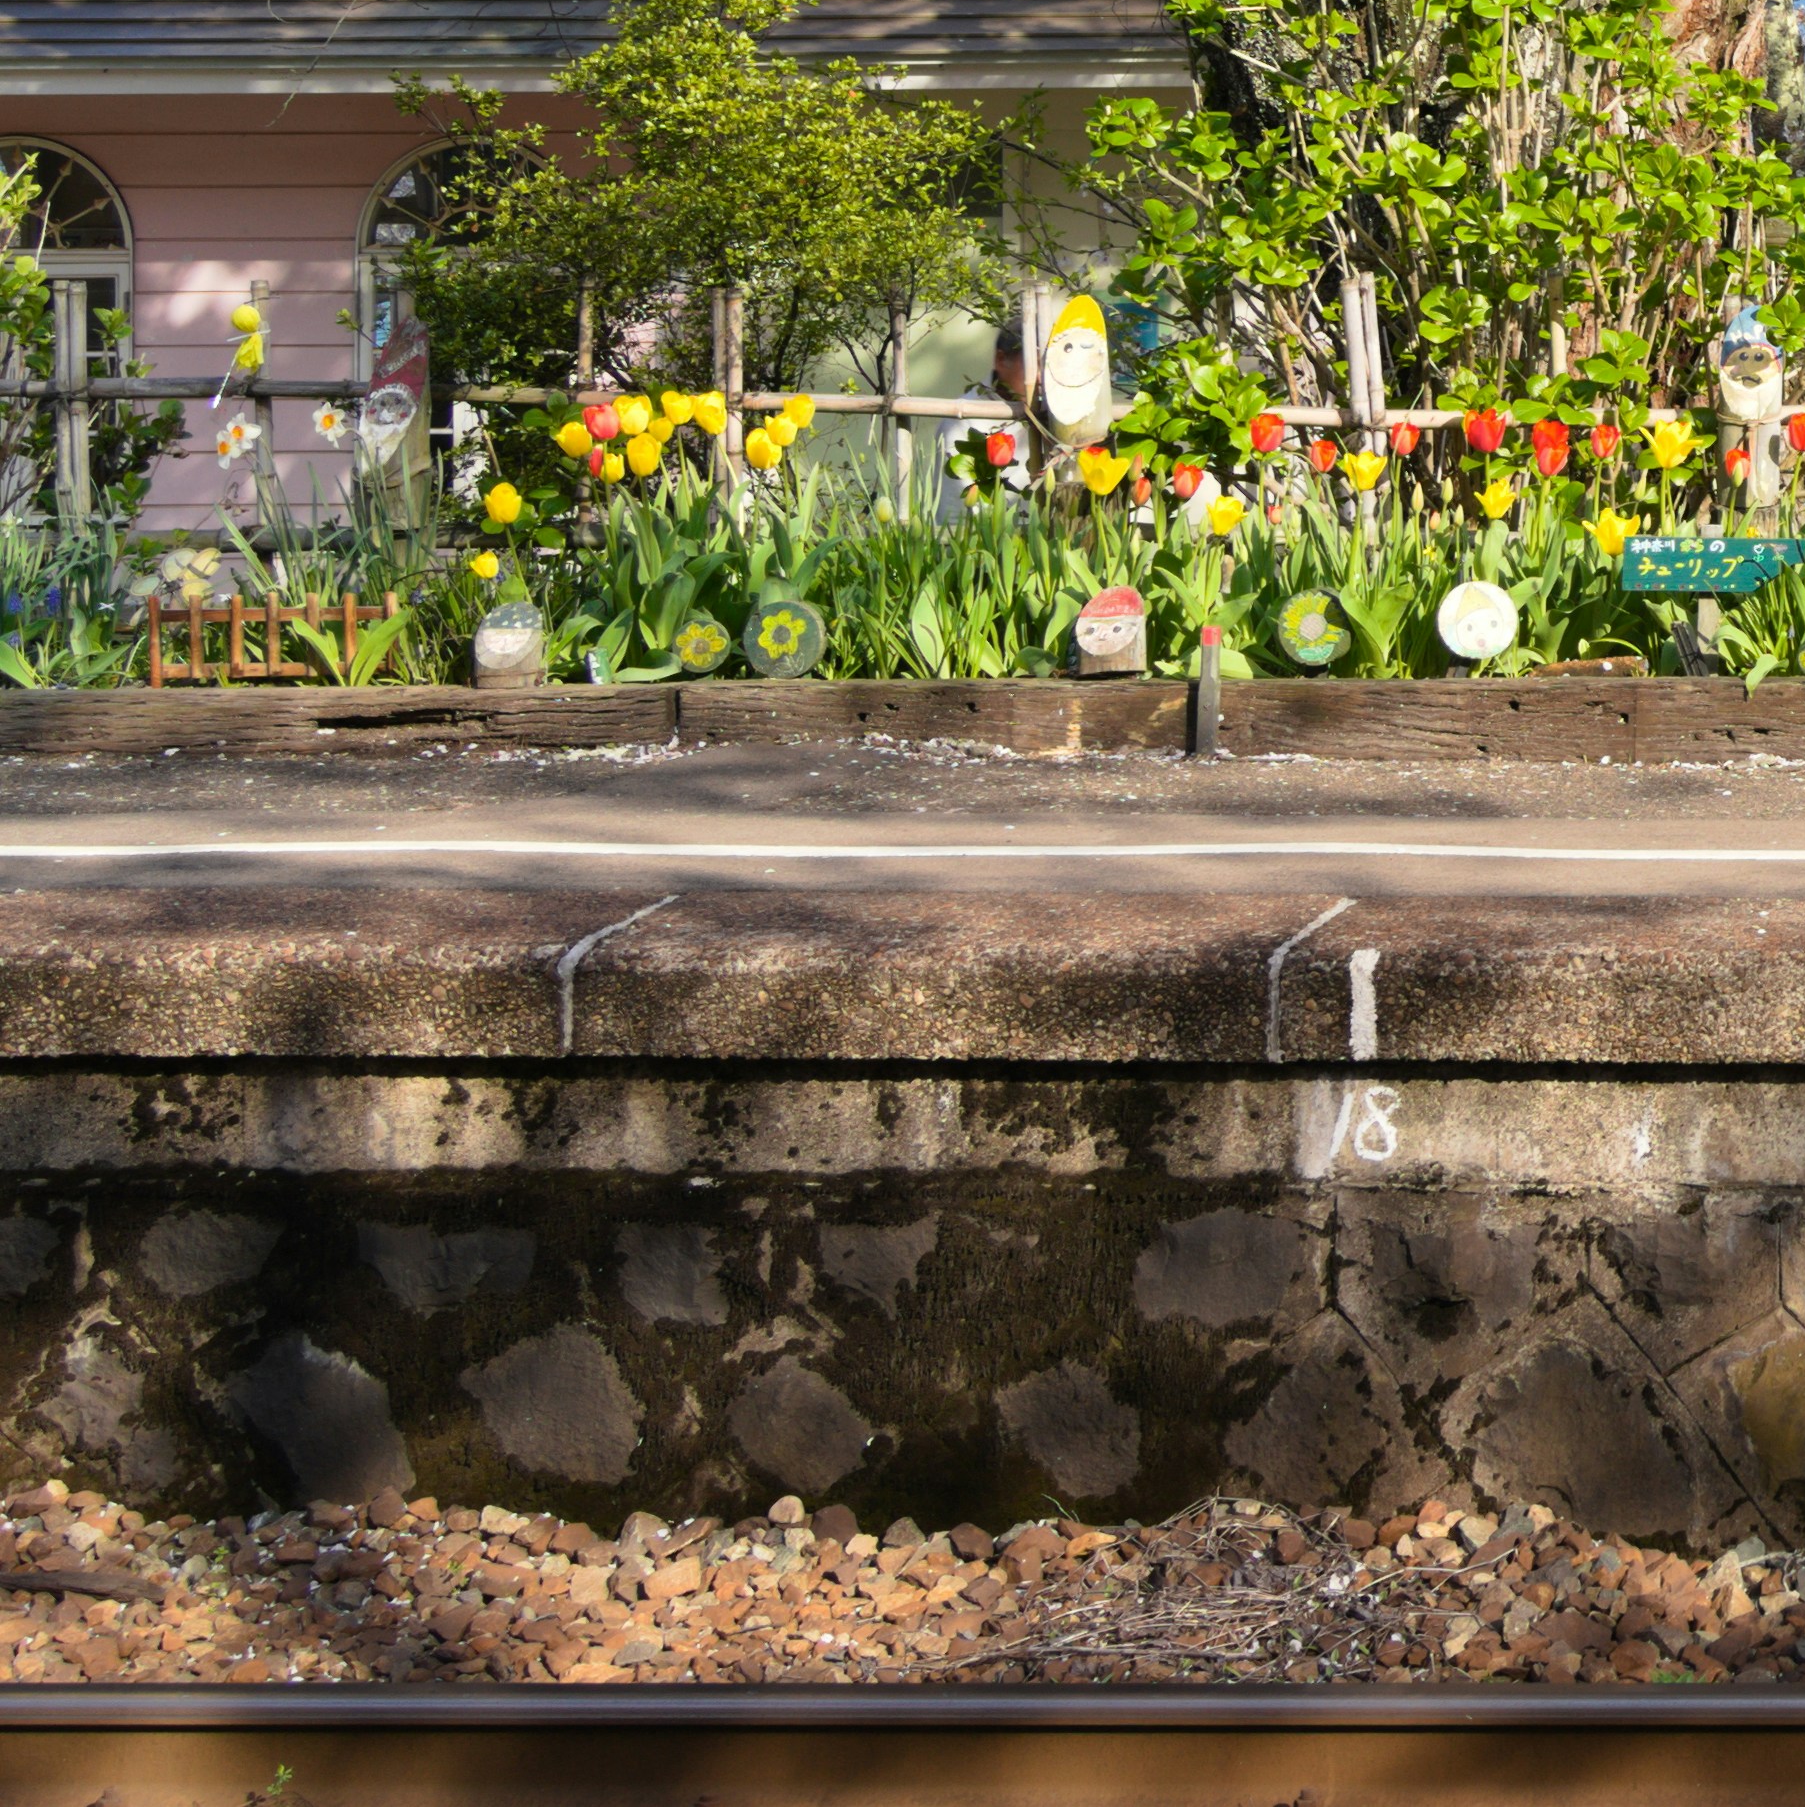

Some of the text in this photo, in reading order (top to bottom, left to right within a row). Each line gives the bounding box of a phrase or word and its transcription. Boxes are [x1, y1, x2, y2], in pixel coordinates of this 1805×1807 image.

[1637, 555, 1745, 579] チューリップ
[1329, 1085, 1402, 1162] 18
